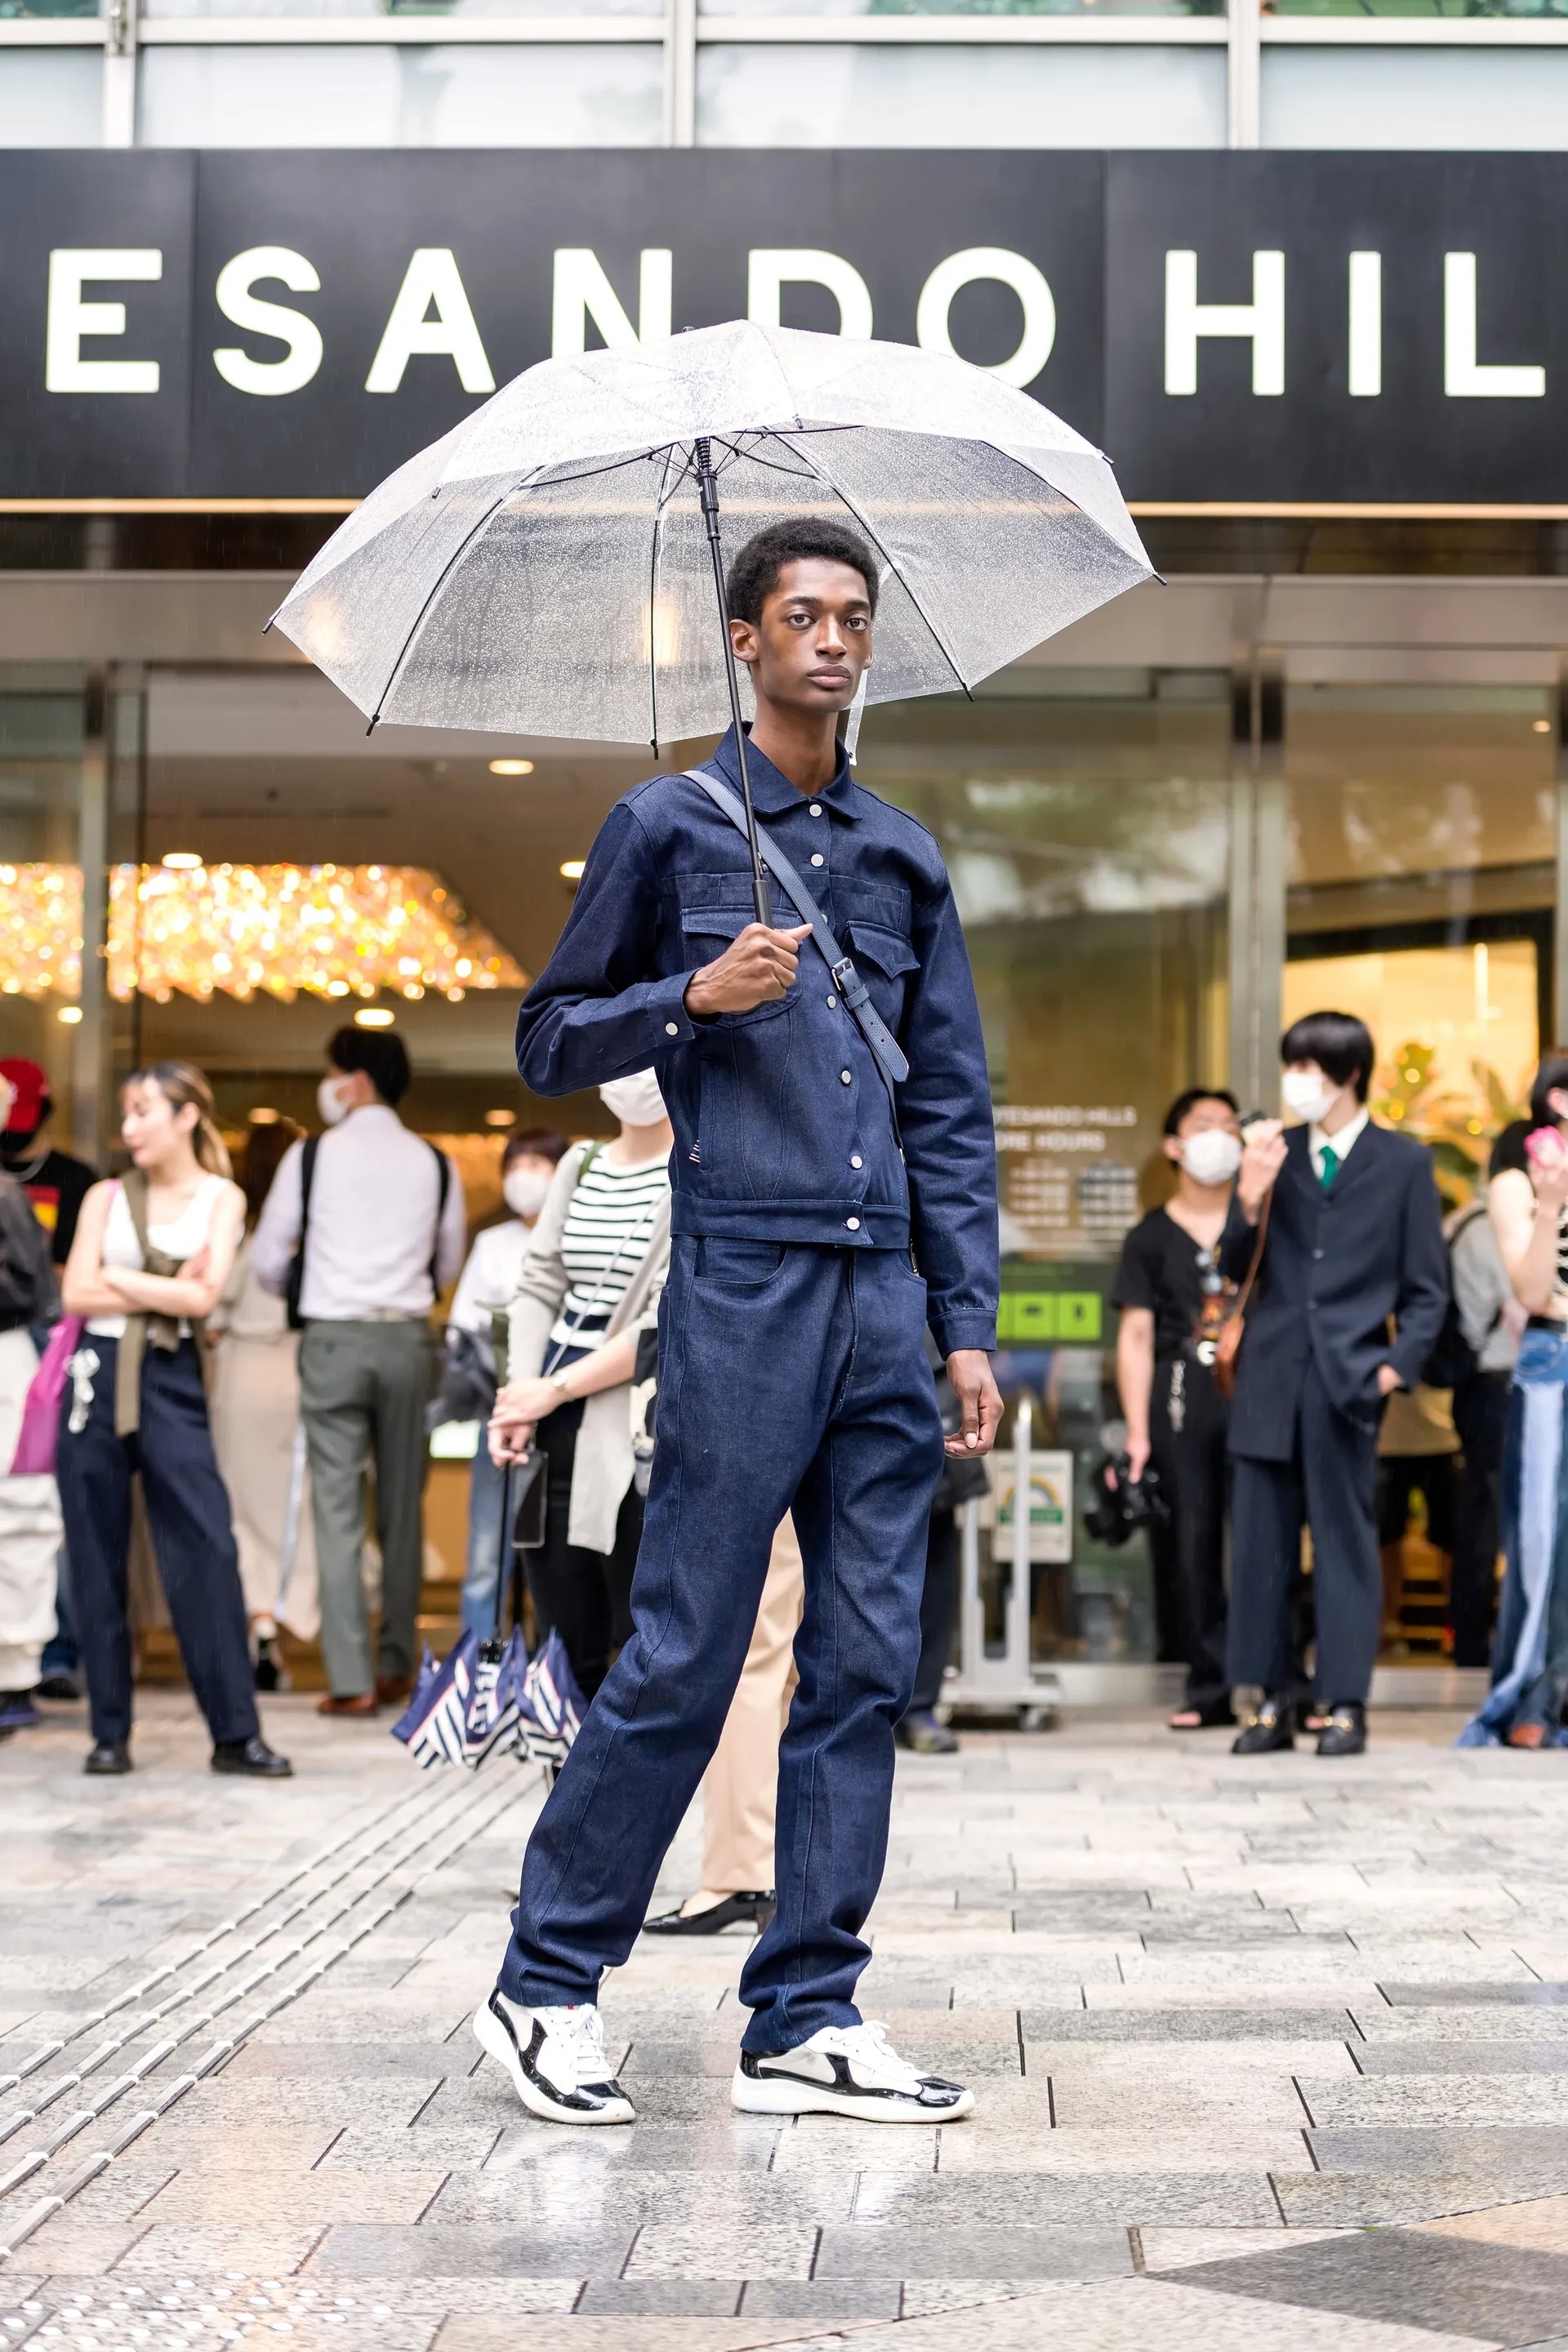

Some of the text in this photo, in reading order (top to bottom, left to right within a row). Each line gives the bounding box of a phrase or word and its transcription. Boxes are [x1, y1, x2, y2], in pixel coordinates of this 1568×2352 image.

[46, 246, 1546, 398] ESANDO HIL
[1034, 1130, 1106, 1152] HOURS
